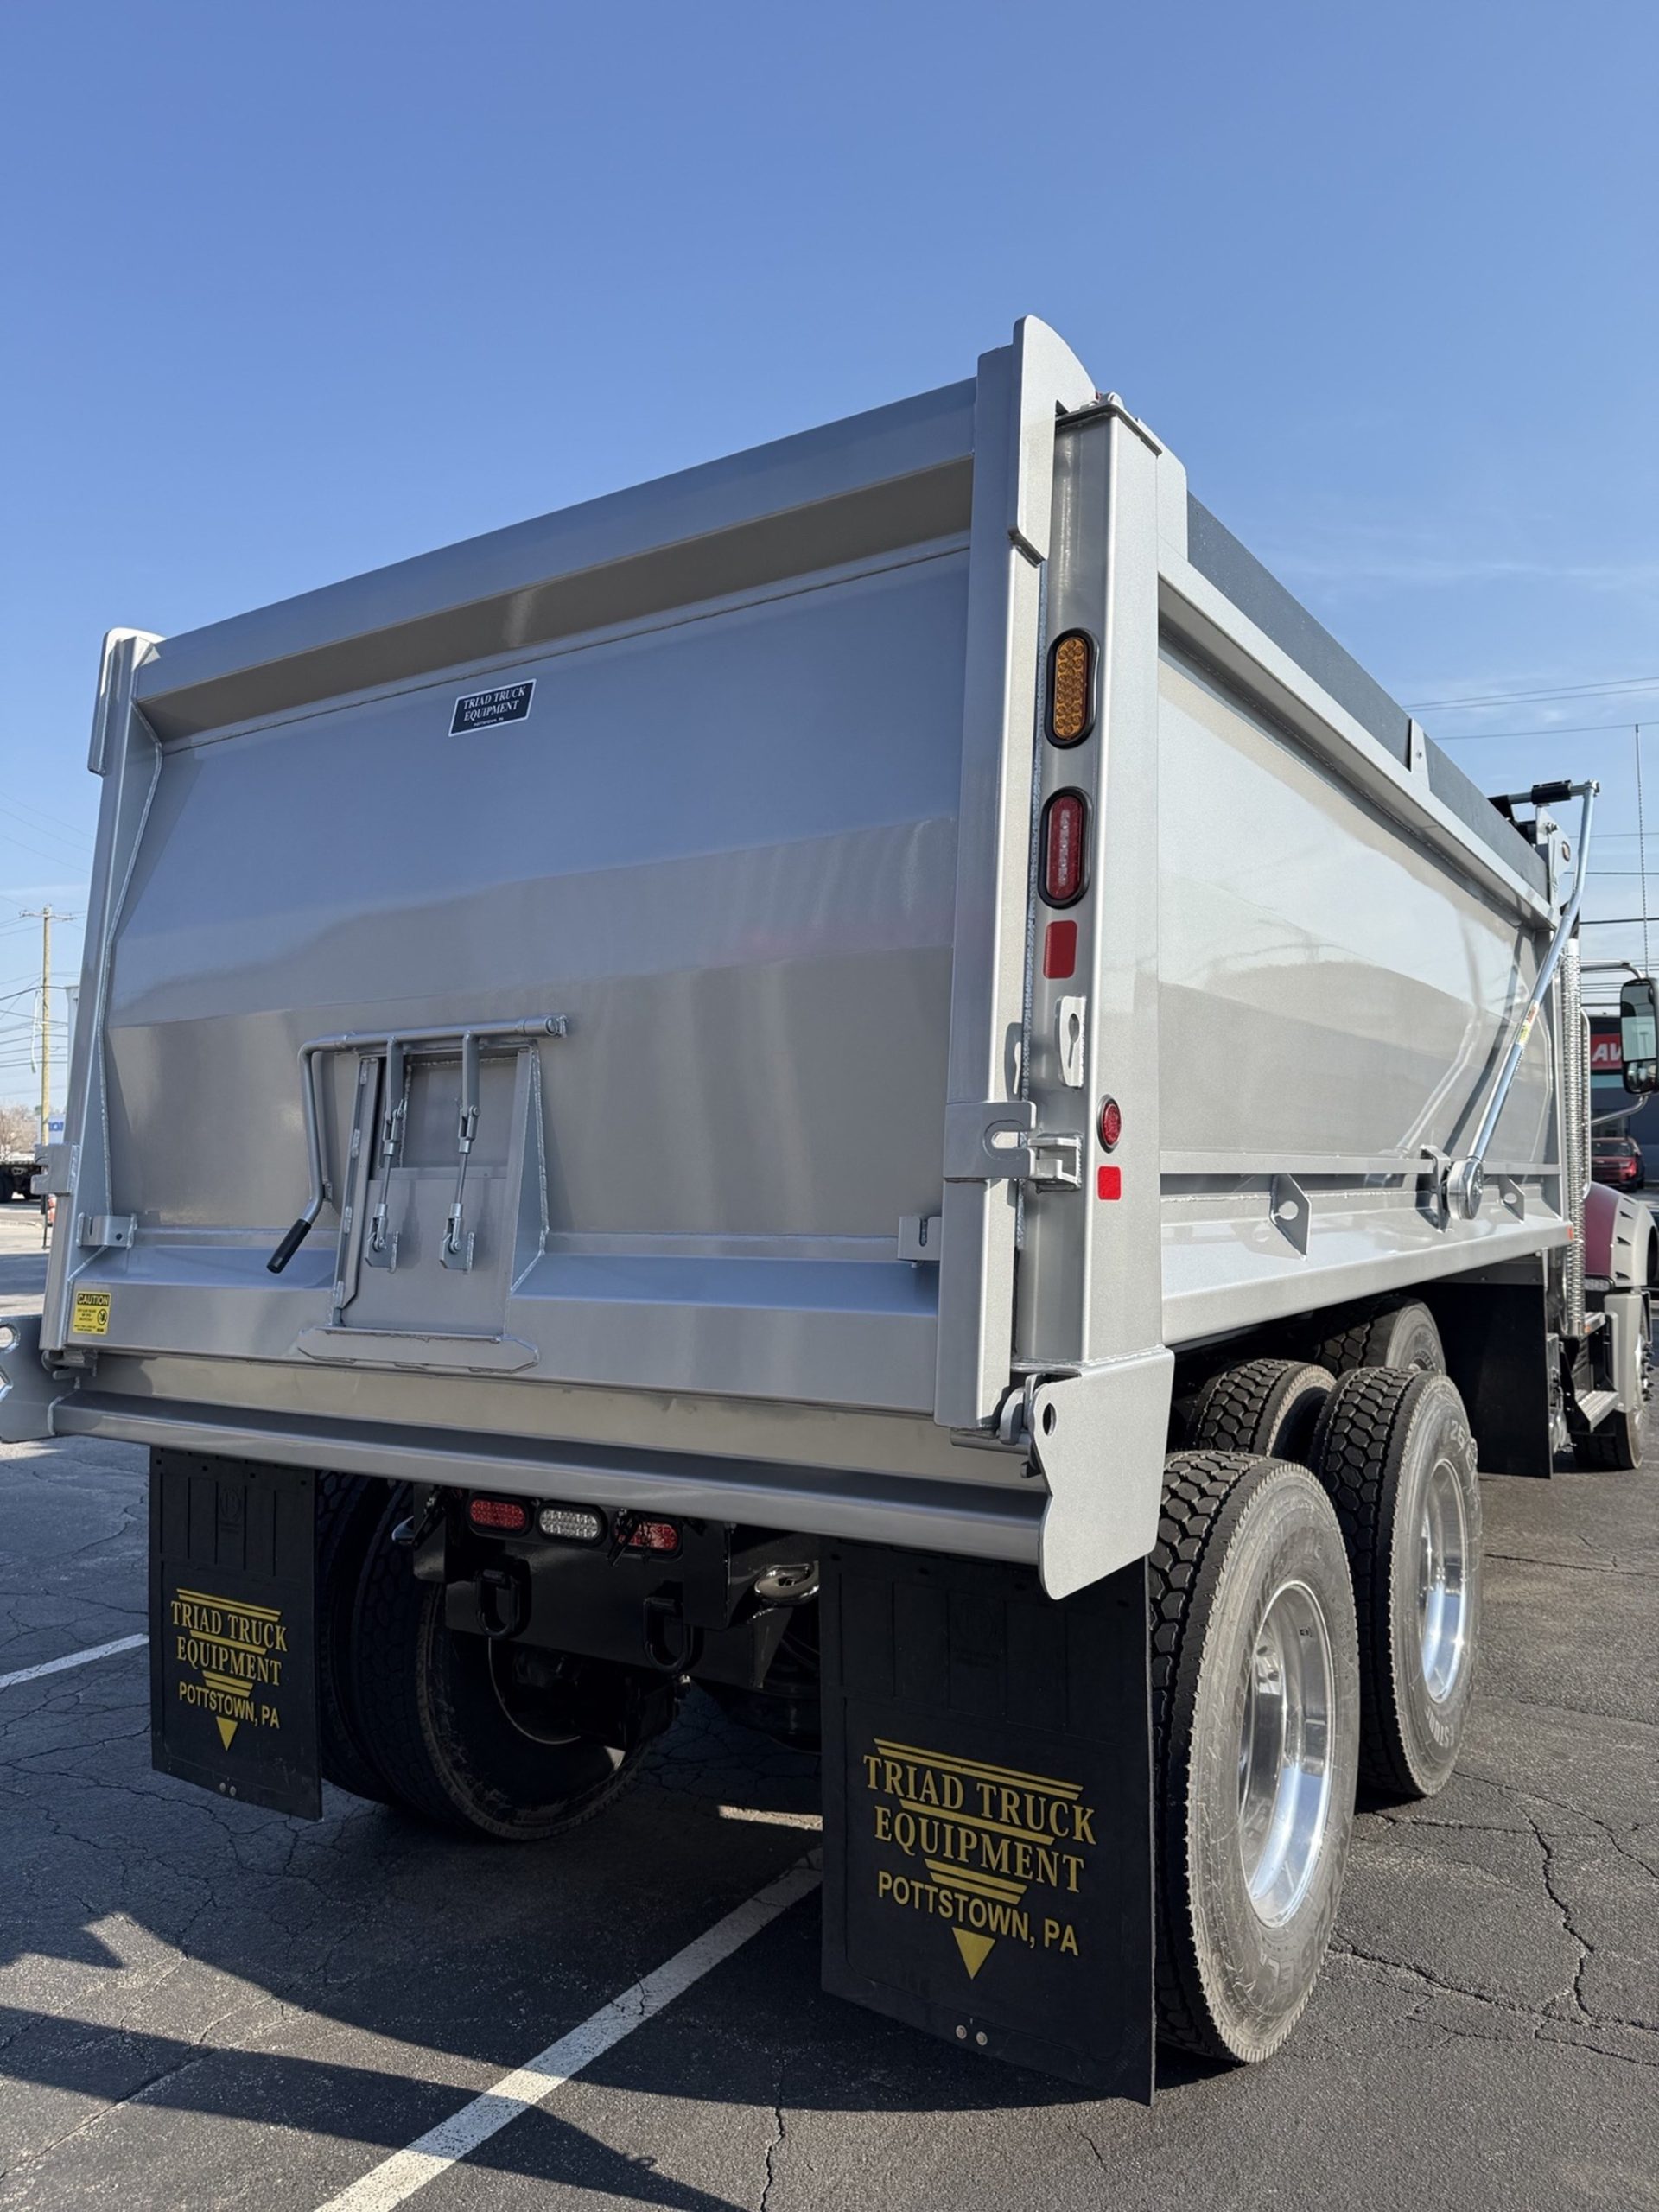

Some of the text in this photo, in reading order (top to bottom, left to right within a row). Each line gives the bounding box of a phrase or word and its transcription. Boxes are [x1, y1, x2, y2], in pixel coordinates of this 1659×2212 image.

[463, 686, 526, 709] TRIAD TRUCK
[463, 700, 519, 721] EQUIPMENT
[79, 1294, 108, 1305] CAUTION
[171, 1600, 288, 1652] TRIAD TRUCK
[176, 1636, 282, 1686] EQUIPMENT
[179, 1681, 280, 1729] POTTSTOWN, PA
[863, 1754, 1096, 1845] TRIAD TRUCK
[874, 1805, 1084, 1893] EQUIPMENT
[878, 1870, 1079, 1956] POTTSTOWN, PA
